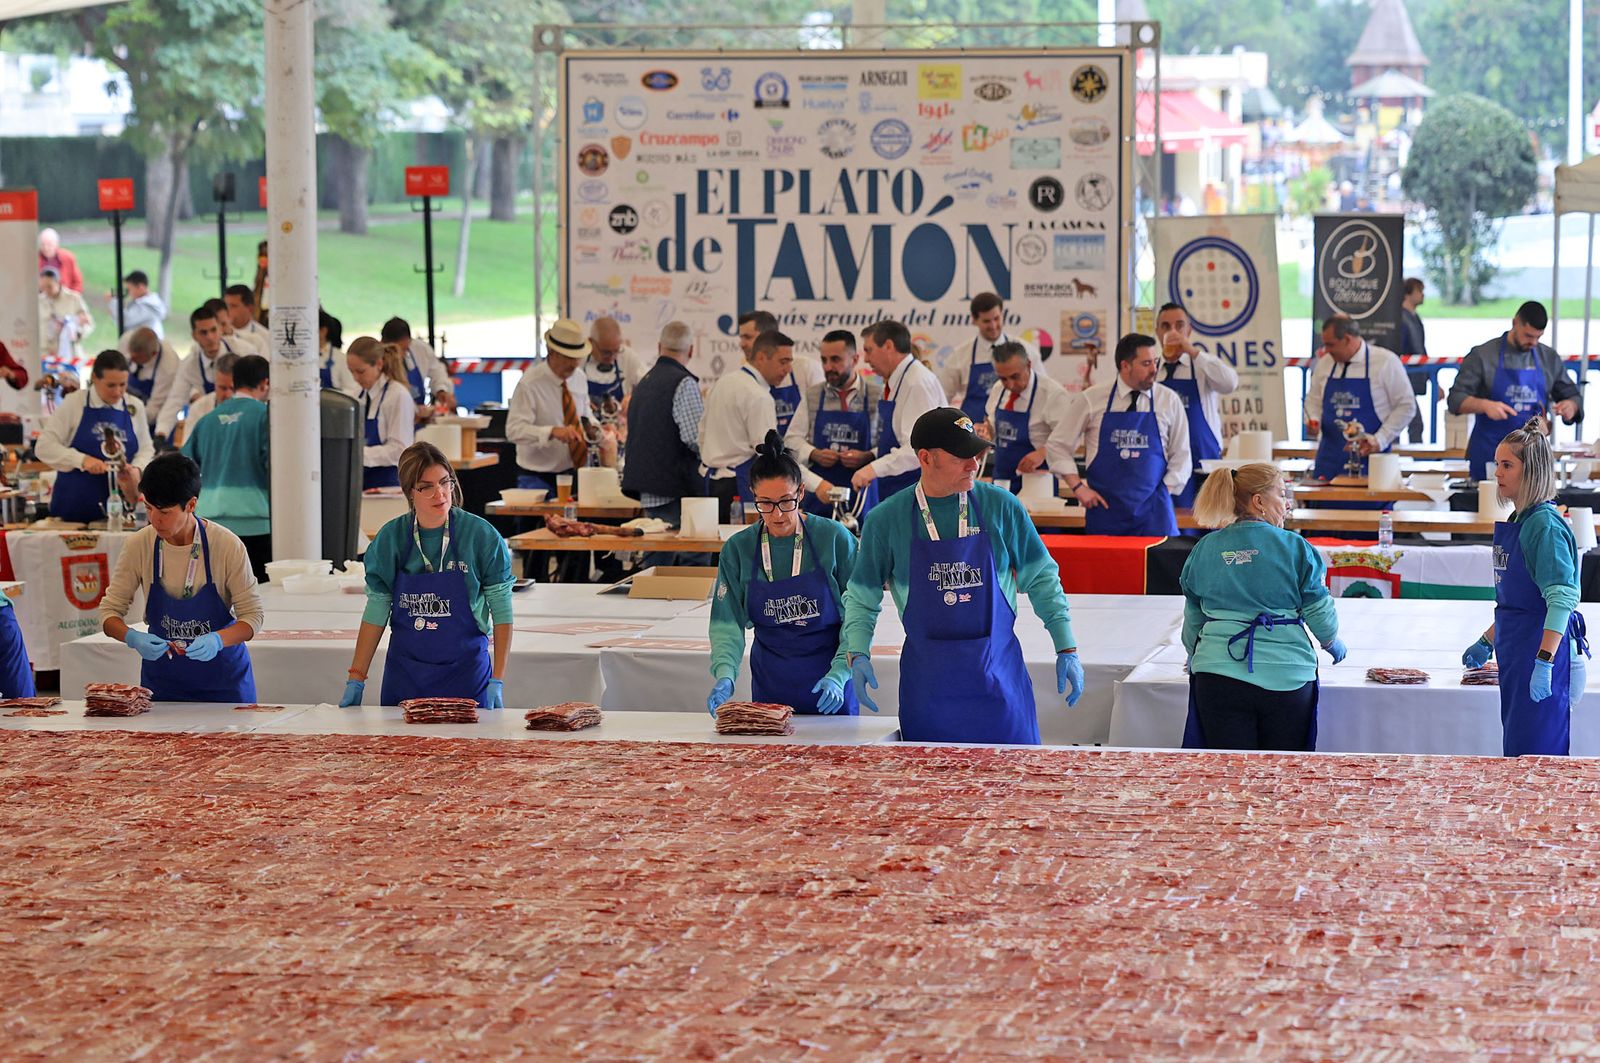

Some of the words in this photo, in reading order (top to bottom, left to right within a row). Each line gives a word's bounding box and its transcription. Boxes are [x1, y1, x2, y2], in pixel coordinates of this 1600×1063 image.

[859, 70, 908, 86] ARNEGUI
[639, 132, 720, 147] Cruzcampo
[763, 168, 924, 216] PLATO
[656, 193, 723, 274] de
[717, 195, 1019, 337] JAMÓN
[901, 308, 937, 326] del
